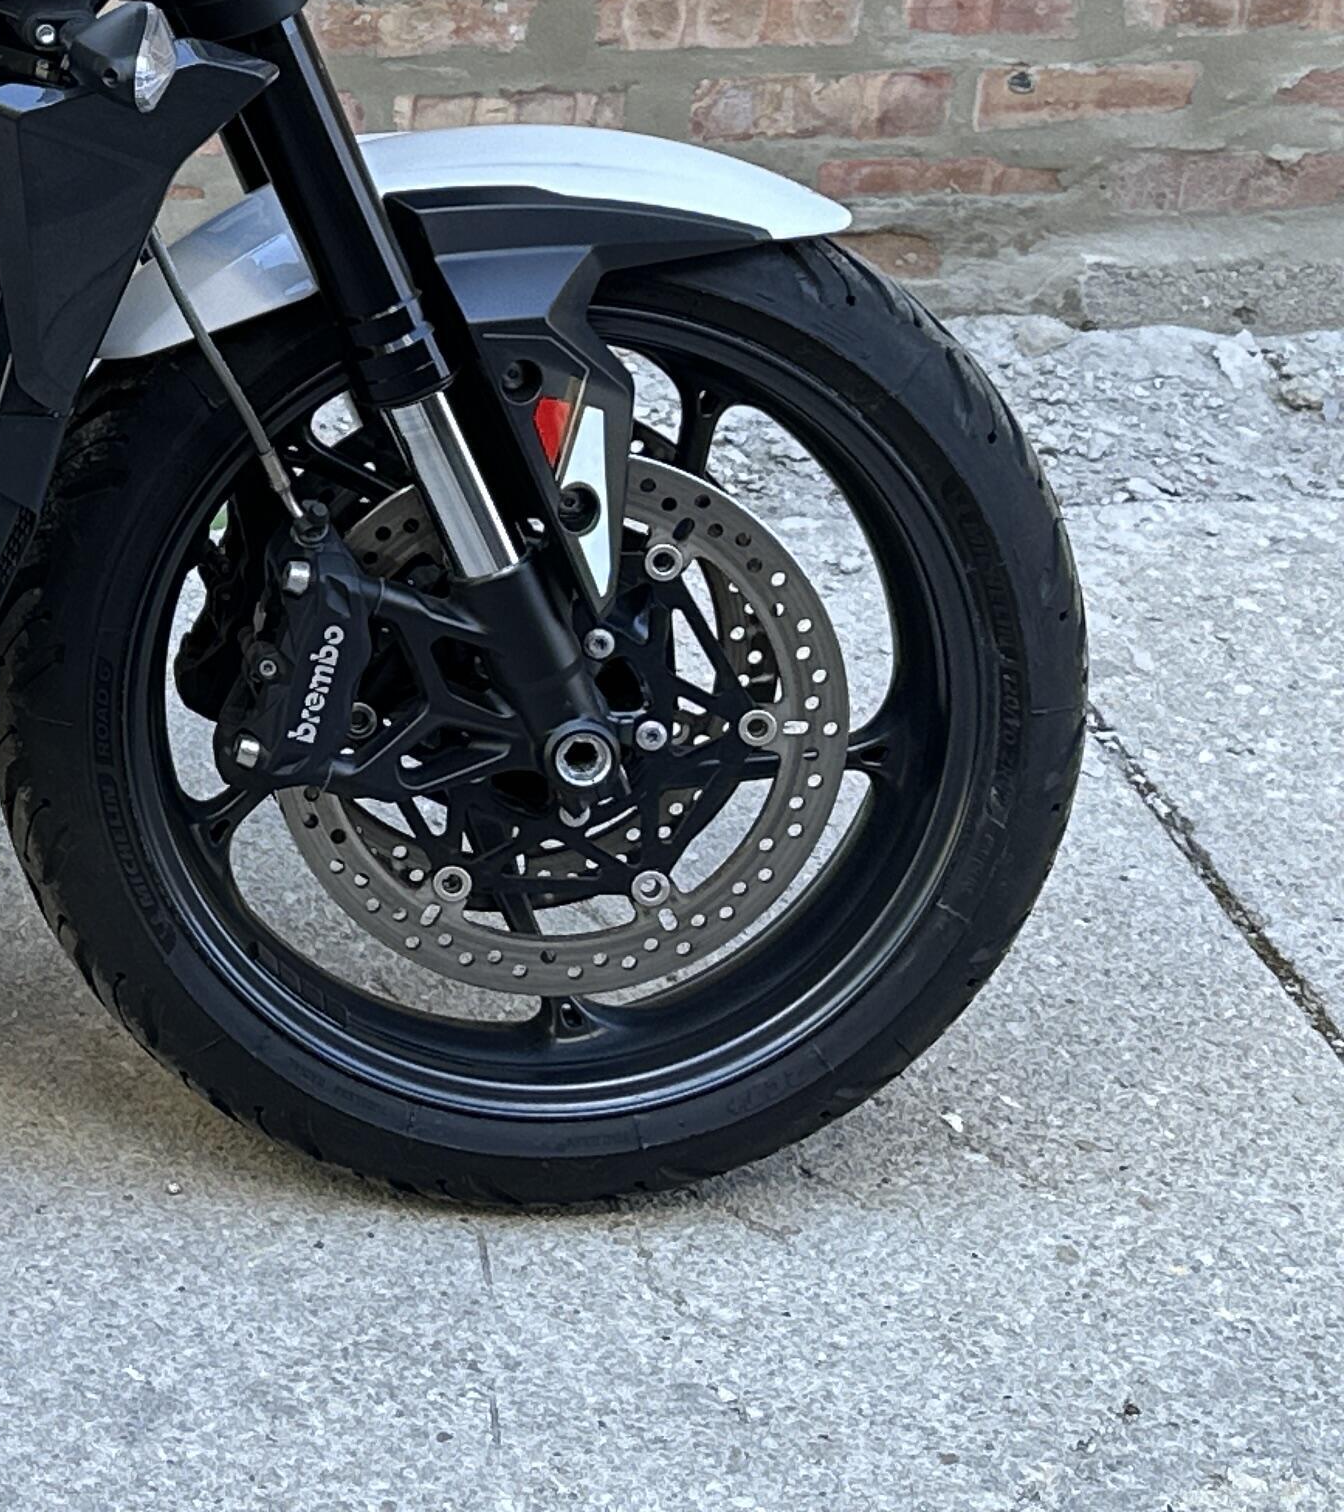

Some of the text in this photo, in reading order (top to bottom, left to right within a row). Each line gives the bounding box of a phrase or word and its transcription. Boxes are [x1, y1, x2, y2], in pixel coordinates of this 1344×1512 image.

[95, 689, 110, 758] ROAD
[286, 624, 345, 744] brembo
[100, 783, 155, 909] MICHELIN
